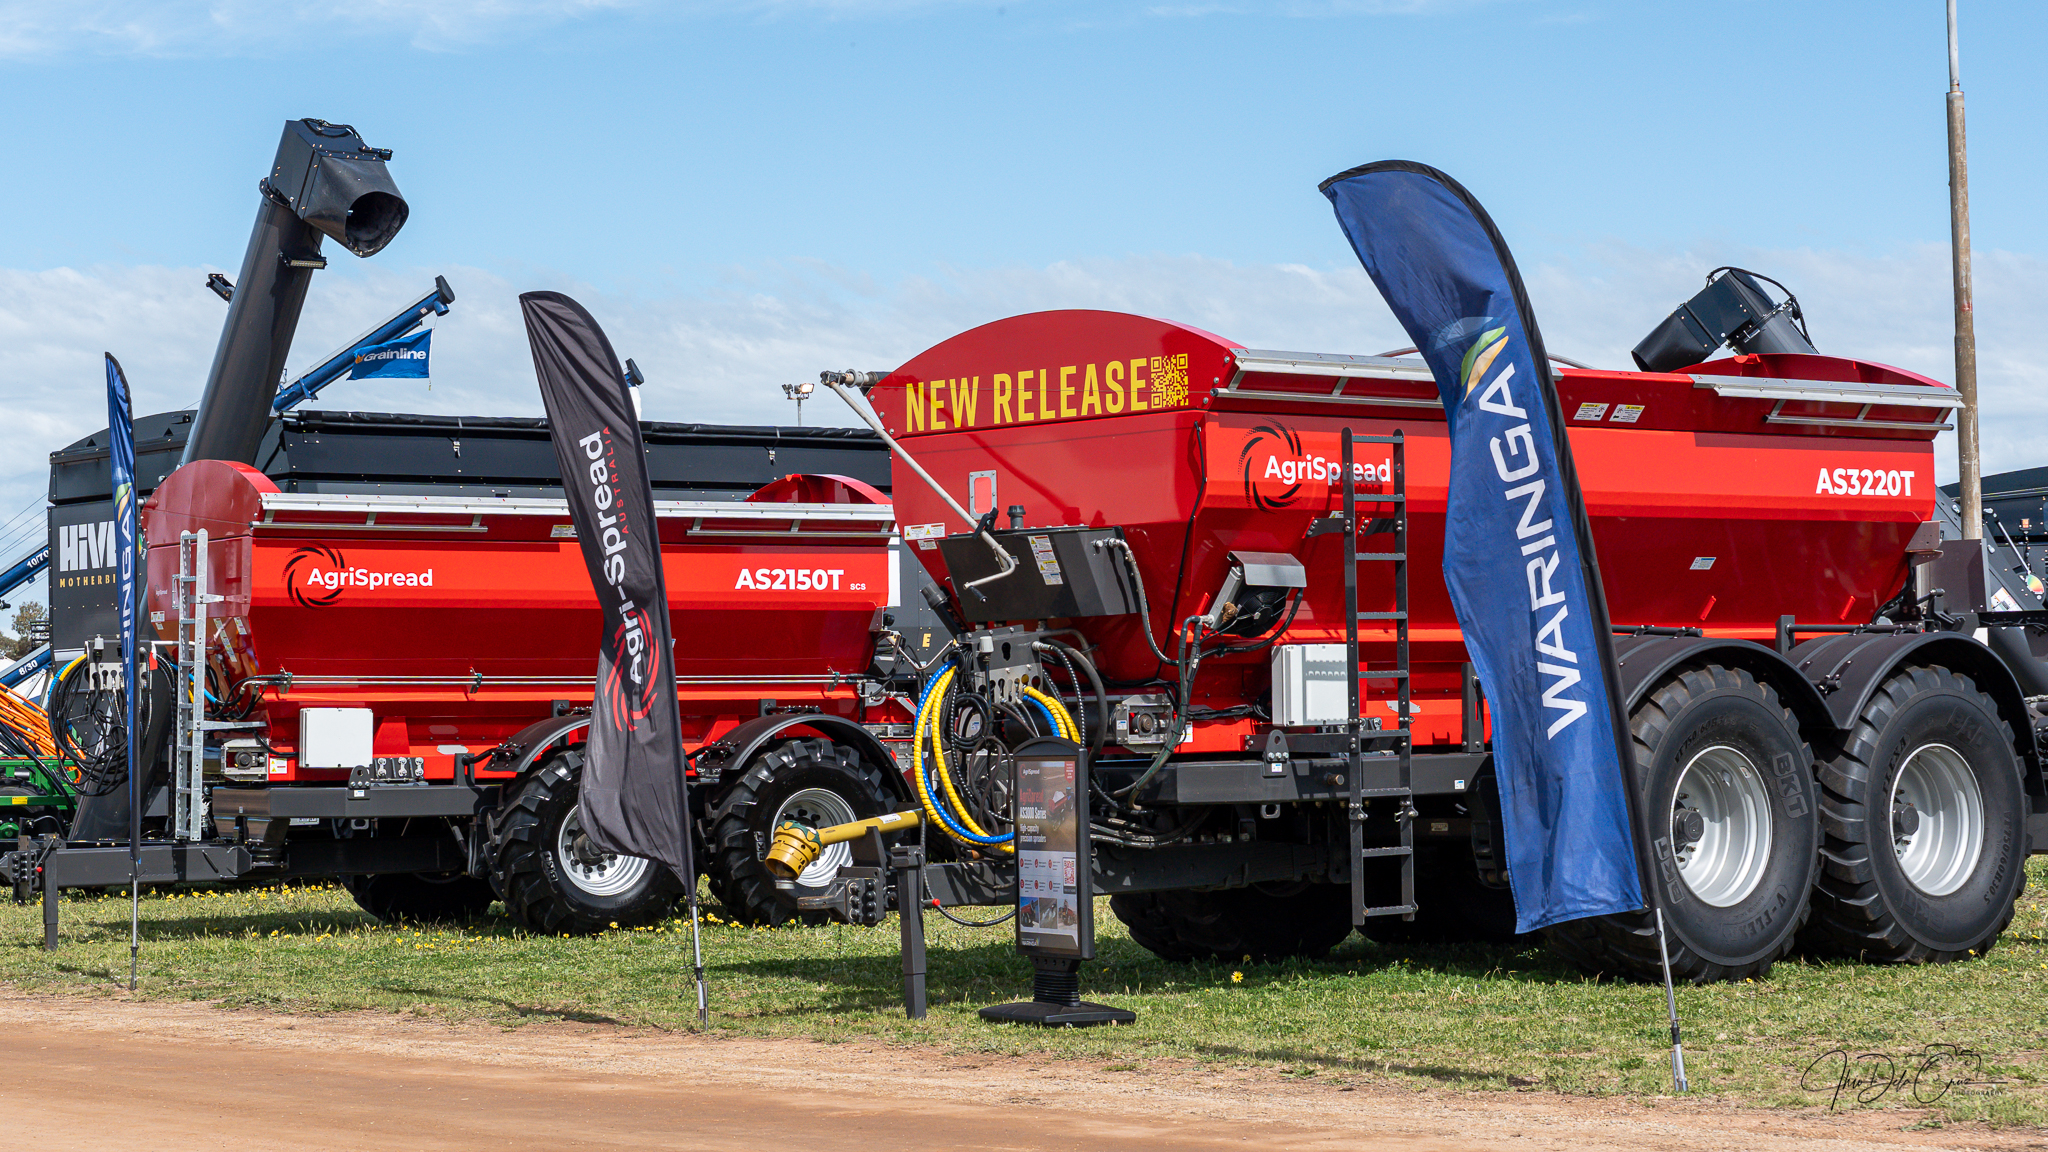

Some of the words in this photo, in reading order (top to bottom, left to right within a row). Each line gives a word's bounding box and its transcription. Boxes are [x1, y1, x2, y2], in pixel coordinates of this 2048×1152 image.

[364, 348, 426, 361] Grainline
[906, 376, 979, 432] NEW
[994, 358, 1148, 424] RELEASE
[603, 426, 629, 534] AUSTRALIA
[1264, 454, 1391, 486] AgriSpead
[1816, 468, 1915, 496] AS3220T
[579, 431, 642, 684] Agri-Spread
[1479, 362, 1587, 740] WARINGA
[307, 567, 433, 590] AgriSpread
[735, 569, 844, 590] AS2150T
[19, 660, 38, 676] 8/30
[1772, 752, 1809, 819] BKT
[755, 831, 767, 862] BKT
